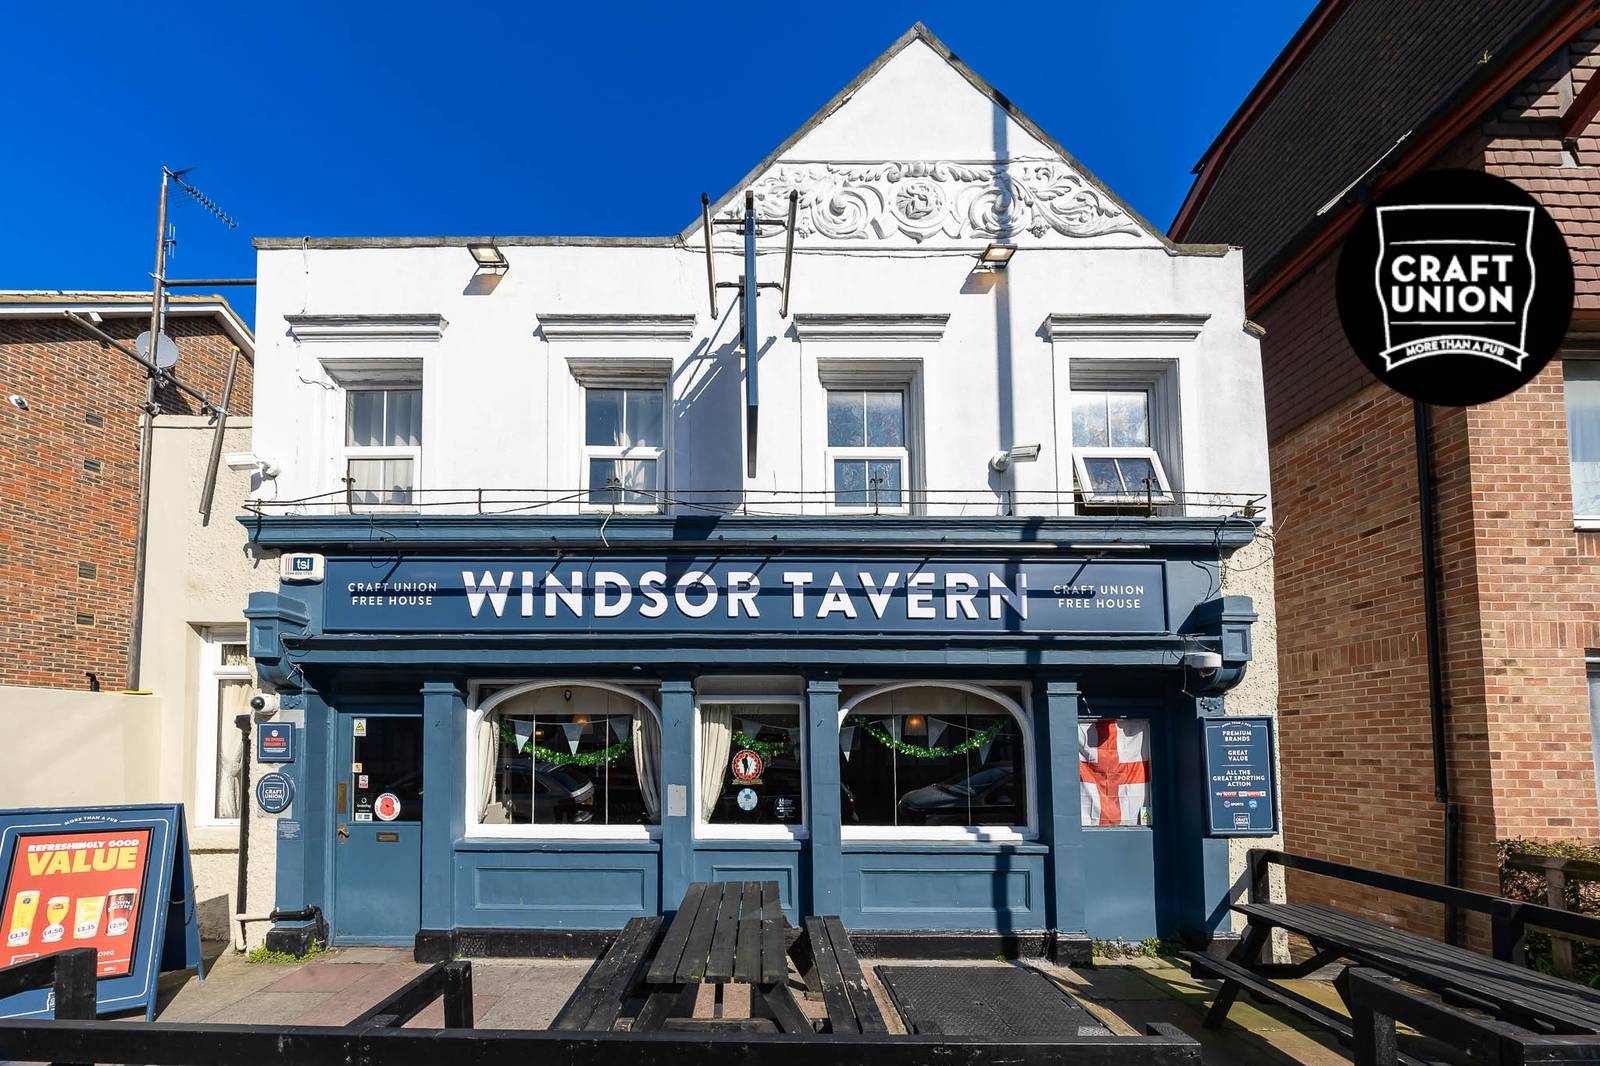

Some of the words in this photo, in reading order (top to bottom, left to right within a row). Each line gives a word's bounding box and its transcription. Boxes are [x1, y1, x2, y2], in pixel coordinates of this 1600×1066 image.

[347, 582, 389, 593] CRAFT
[393, 582, 438, 593] UNION
[1053, 584, 1096, 596] CRAFT
[1100, 584, 1145, 596] UNION
[461, 570, 761, 619] WINDSOR
[782, 570, 1029, 620] TAVERN
[351, 596, 384, 606] FREE
[388, 596, 433, 606] HOUSE
[1057, 598, 1091, 609] FREE
[1096, 598, 1141, 609] HOUSE
[64, 817, 82, 826] MORE
[27, 841, 105, 853] REFRESHINGLY
[108, 839, 140, 848] GOOD
[27, 846, 138, 877] VALUE
[43, 927, 63, 937] £4.50
[97, 949, 115, 957] ONG
